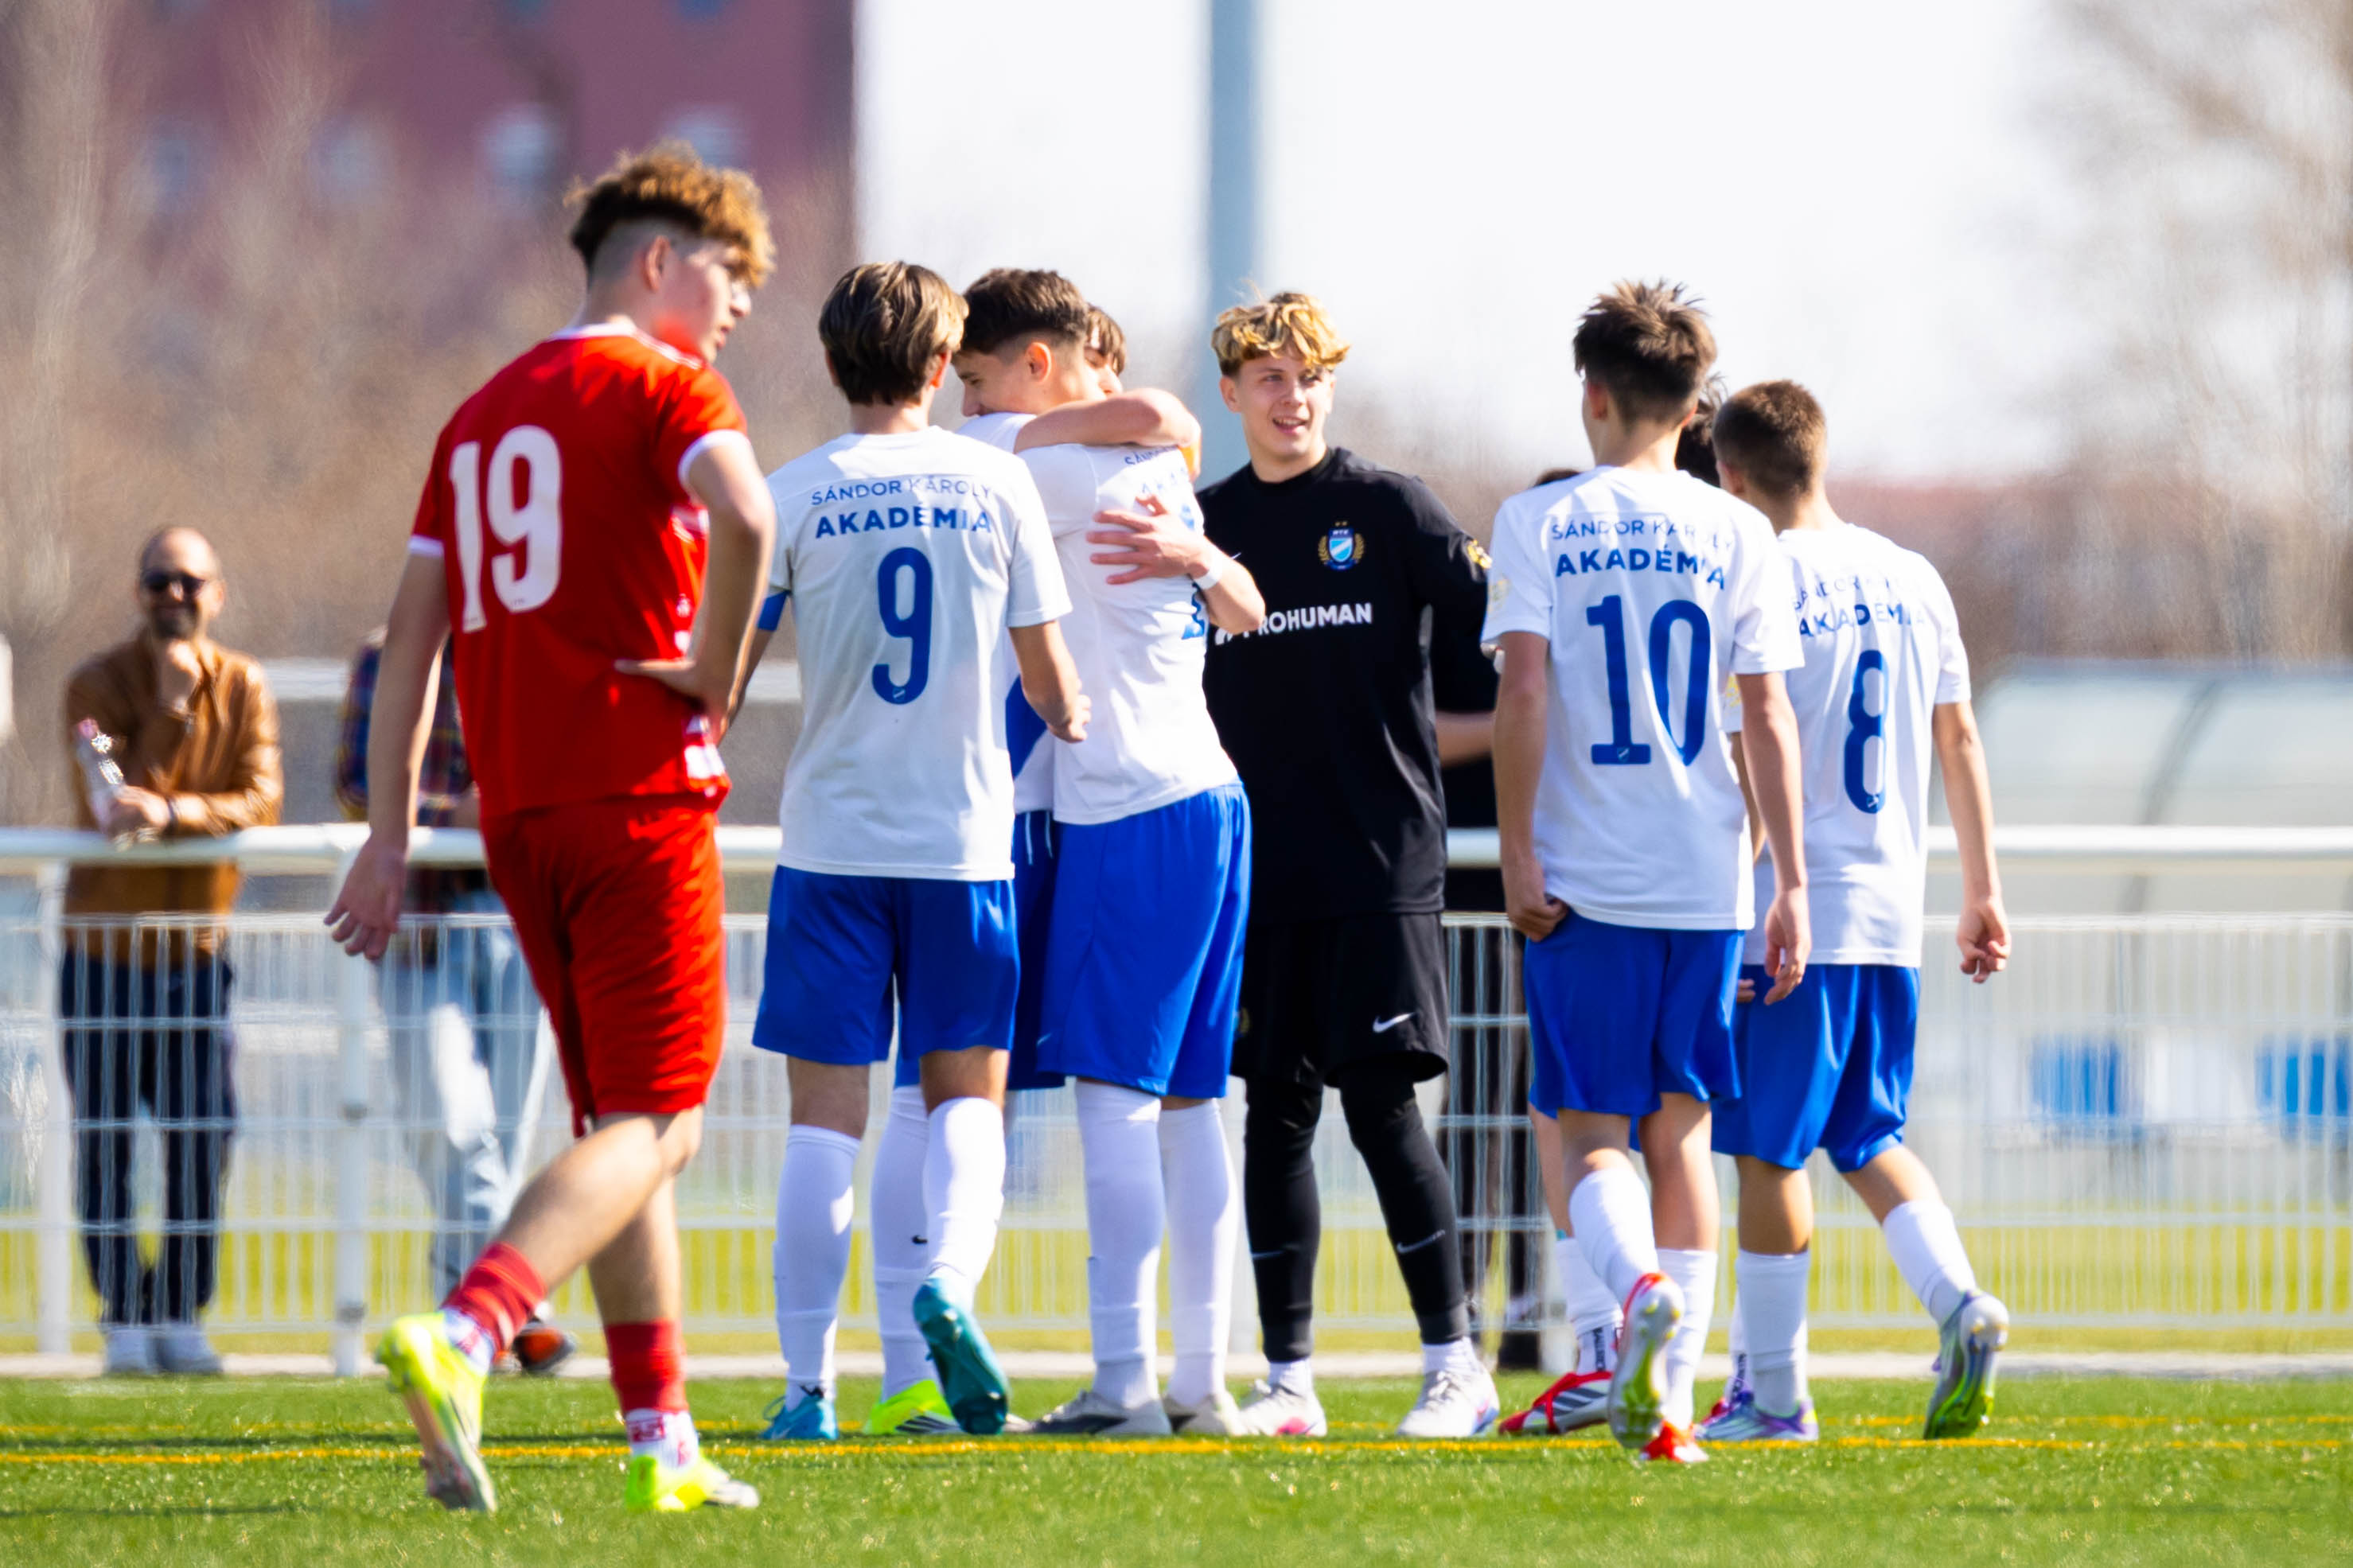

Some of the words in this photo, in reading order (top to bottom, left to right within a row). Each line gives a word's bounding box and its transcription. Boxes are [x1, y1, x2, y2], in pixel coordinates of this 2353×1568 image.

[449, 424, 563, 633] 19
[811, 480, 902, 505] SÁNDOR
[815, 501, 992, 539] AKADÉMIA
[1551, 519, 1645, 540] SÁNDOR
[871, 547, 933, 705] 9
[1242, 602, 1373, 638] ROHUMAN
[1586, 594, 1711, 766] 10
[1844, 649, 1890, 815] 8
